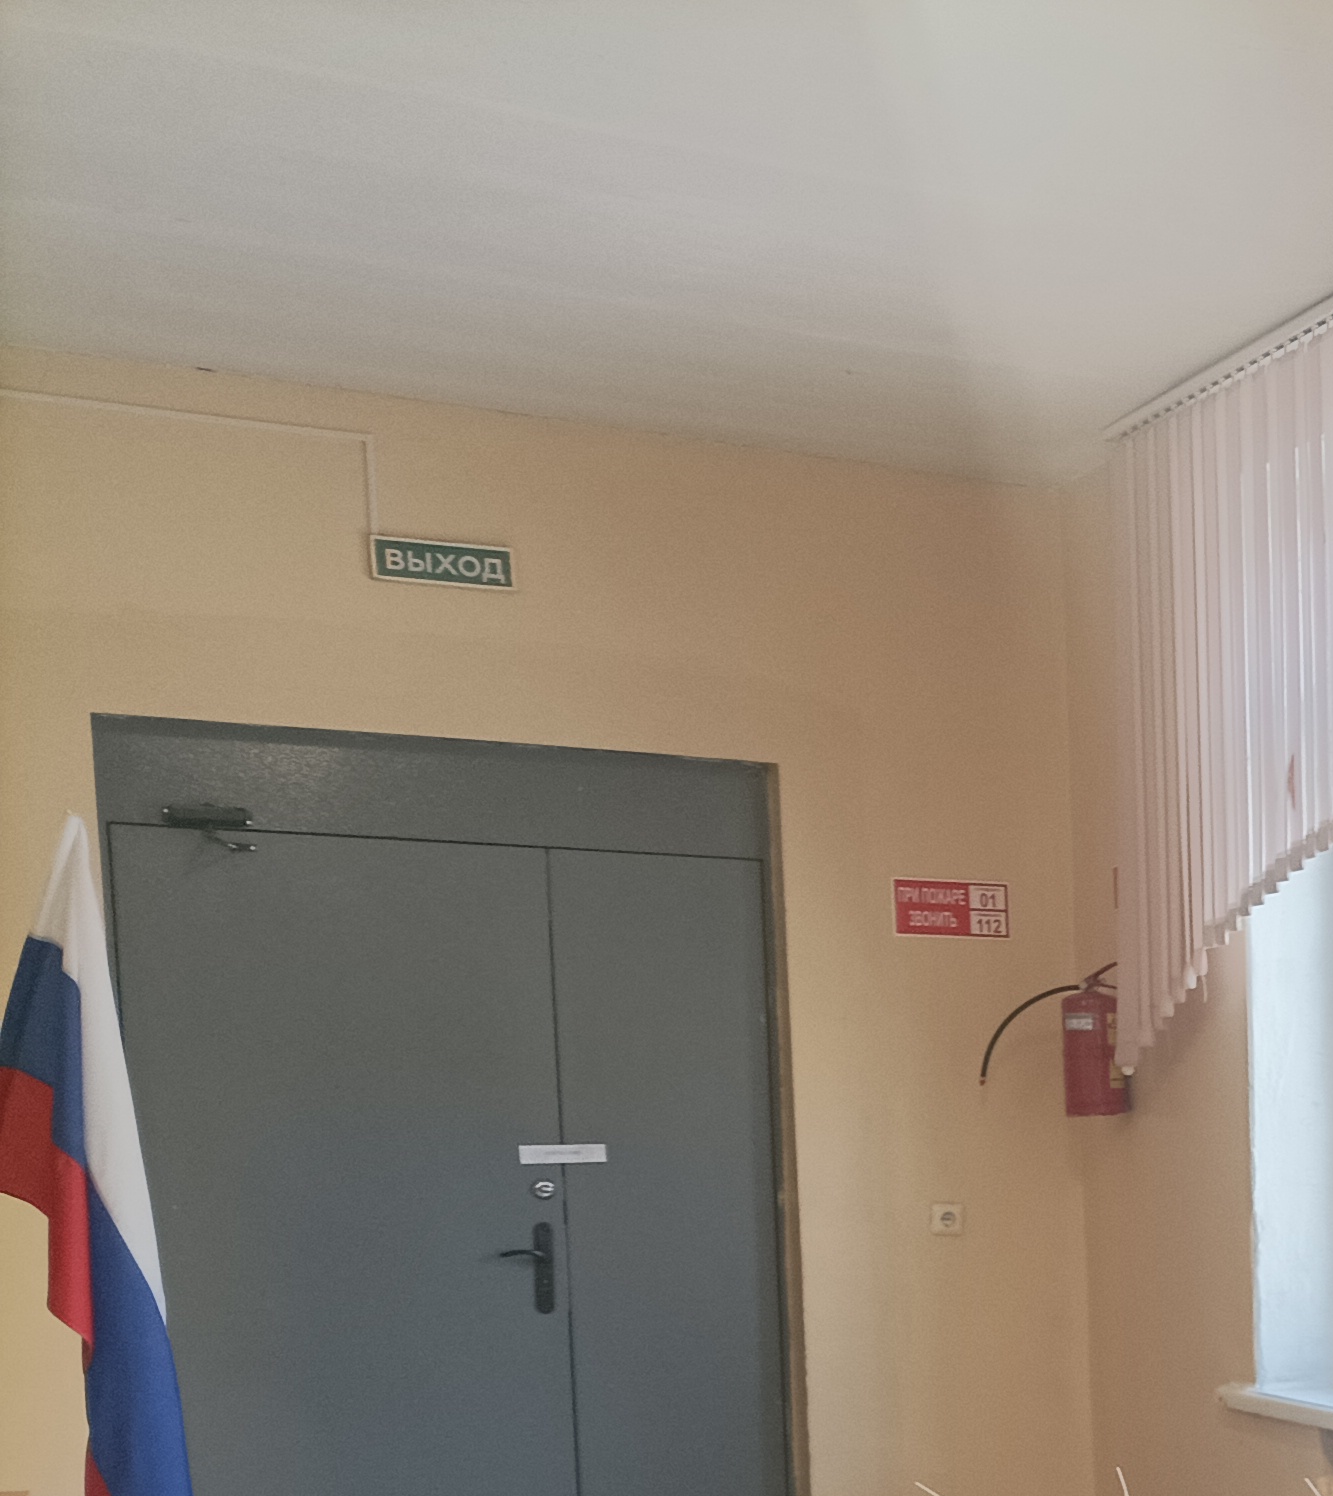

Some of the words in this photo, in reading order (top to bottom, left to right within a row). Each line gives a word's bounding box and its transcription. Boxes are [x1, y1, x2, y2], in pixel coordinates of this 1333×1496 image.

[384, 548, 506, 584] ВЫХОД
[979, 892, 998, 908] 01
[976, 918, 1003, 934] 112
